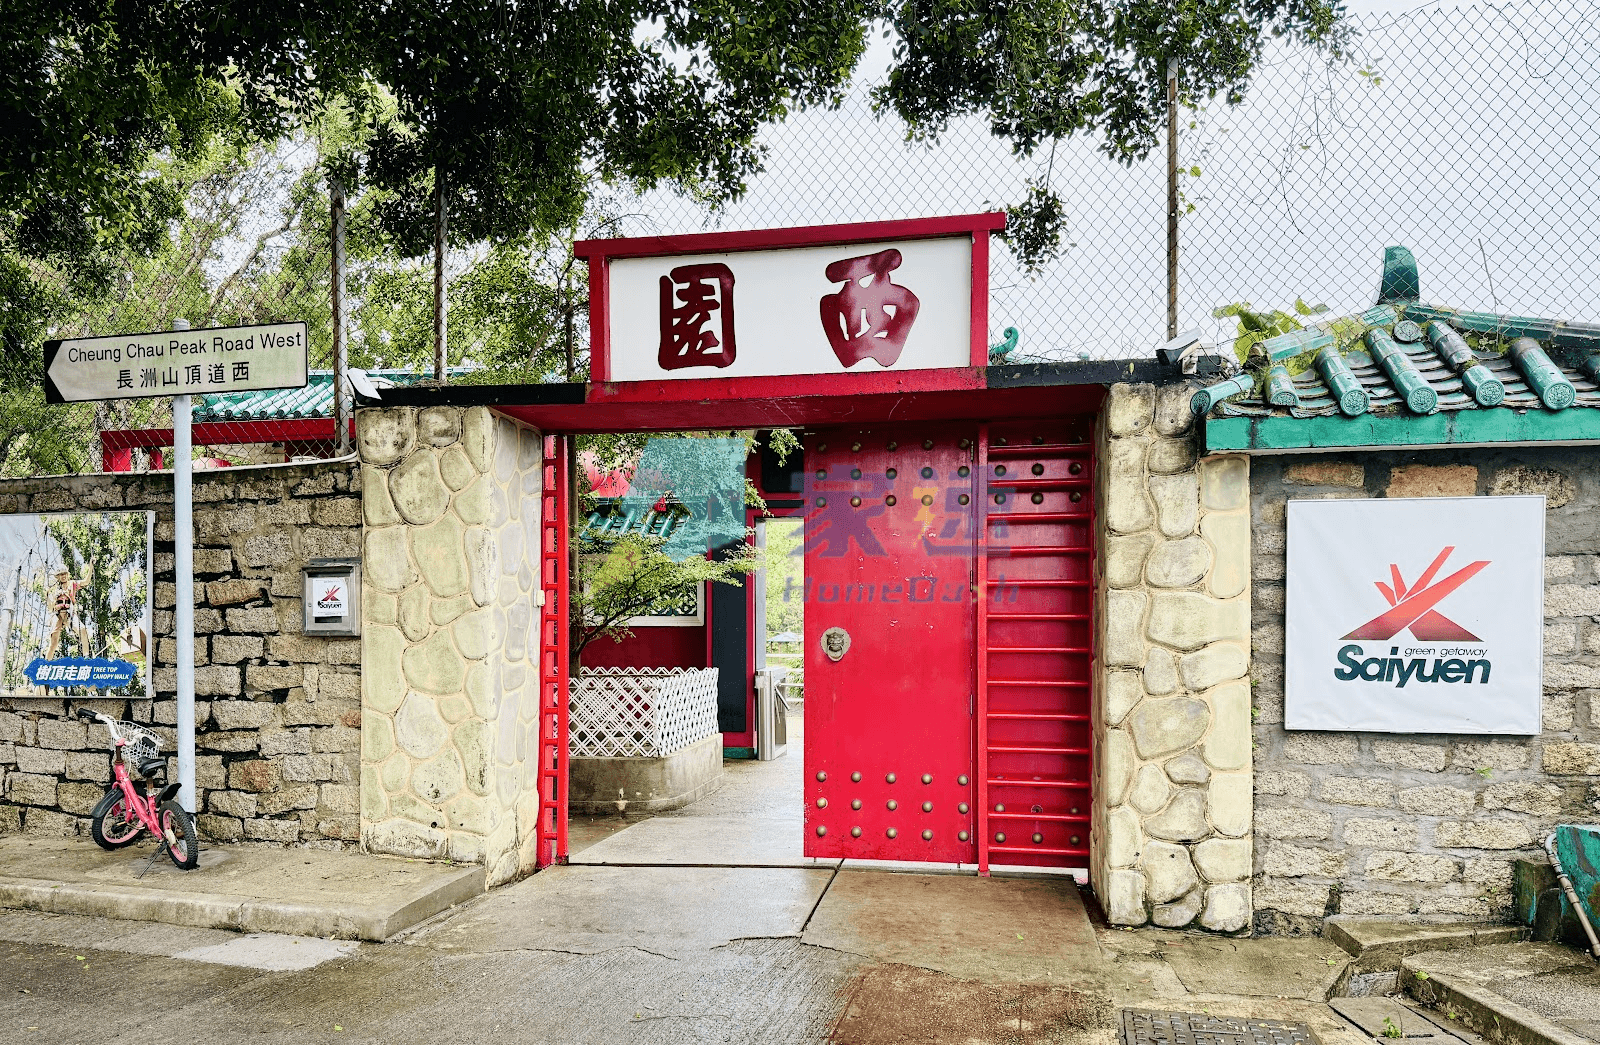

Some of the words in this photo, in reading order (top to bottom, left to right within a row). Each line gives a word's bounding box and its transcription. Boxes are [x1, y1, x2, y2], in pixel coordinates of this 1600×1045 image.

[68, 346, 121, 363] Cheung
[126, 341, 164, 359] Chau
[169, 339, 207, 356] Peak
[212, 336, 254, 353] Road
[259, 331, 302, 349] West
[116, 361, 250, 390] 長洲山頂道西
[1334, 644, 1492, 688] Saiyuen
[1404, 647, 1436, 657] green
[1440, 647, 1488, 658] getaway
